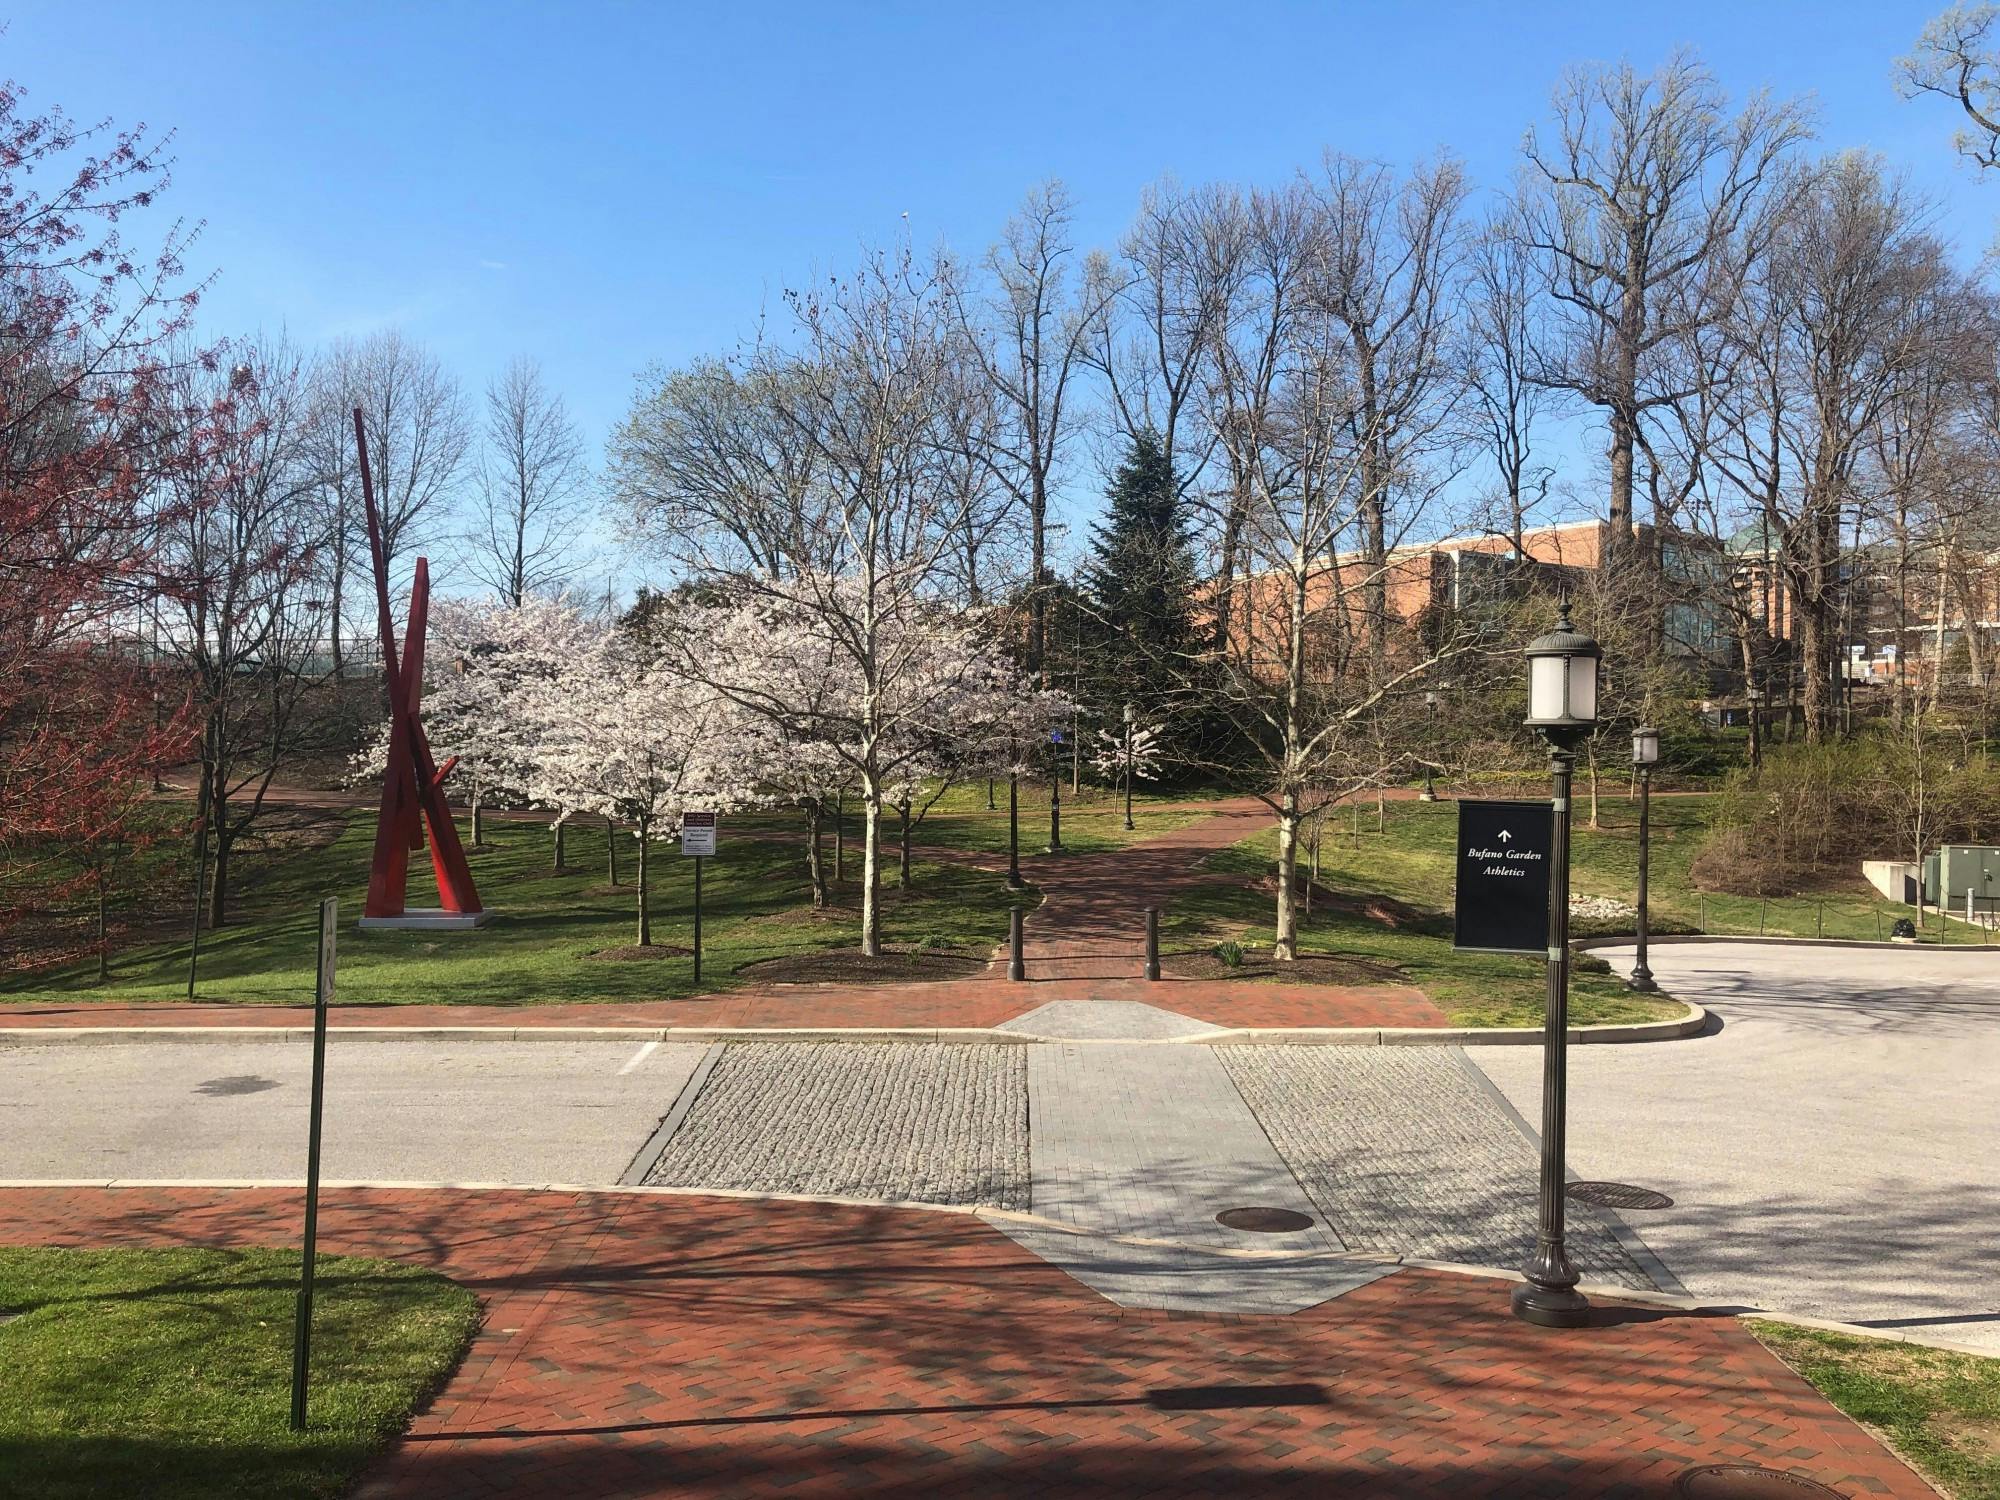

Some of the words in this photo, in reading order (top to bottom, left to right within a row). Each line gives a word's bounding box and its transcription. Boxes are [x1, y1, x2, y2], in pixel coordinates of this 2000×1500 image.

[1467, 848, 1503, 861] Bufano
[1505, 849, 1542, 860] Garden
[1482, 865, 1526, 877] Athletics
